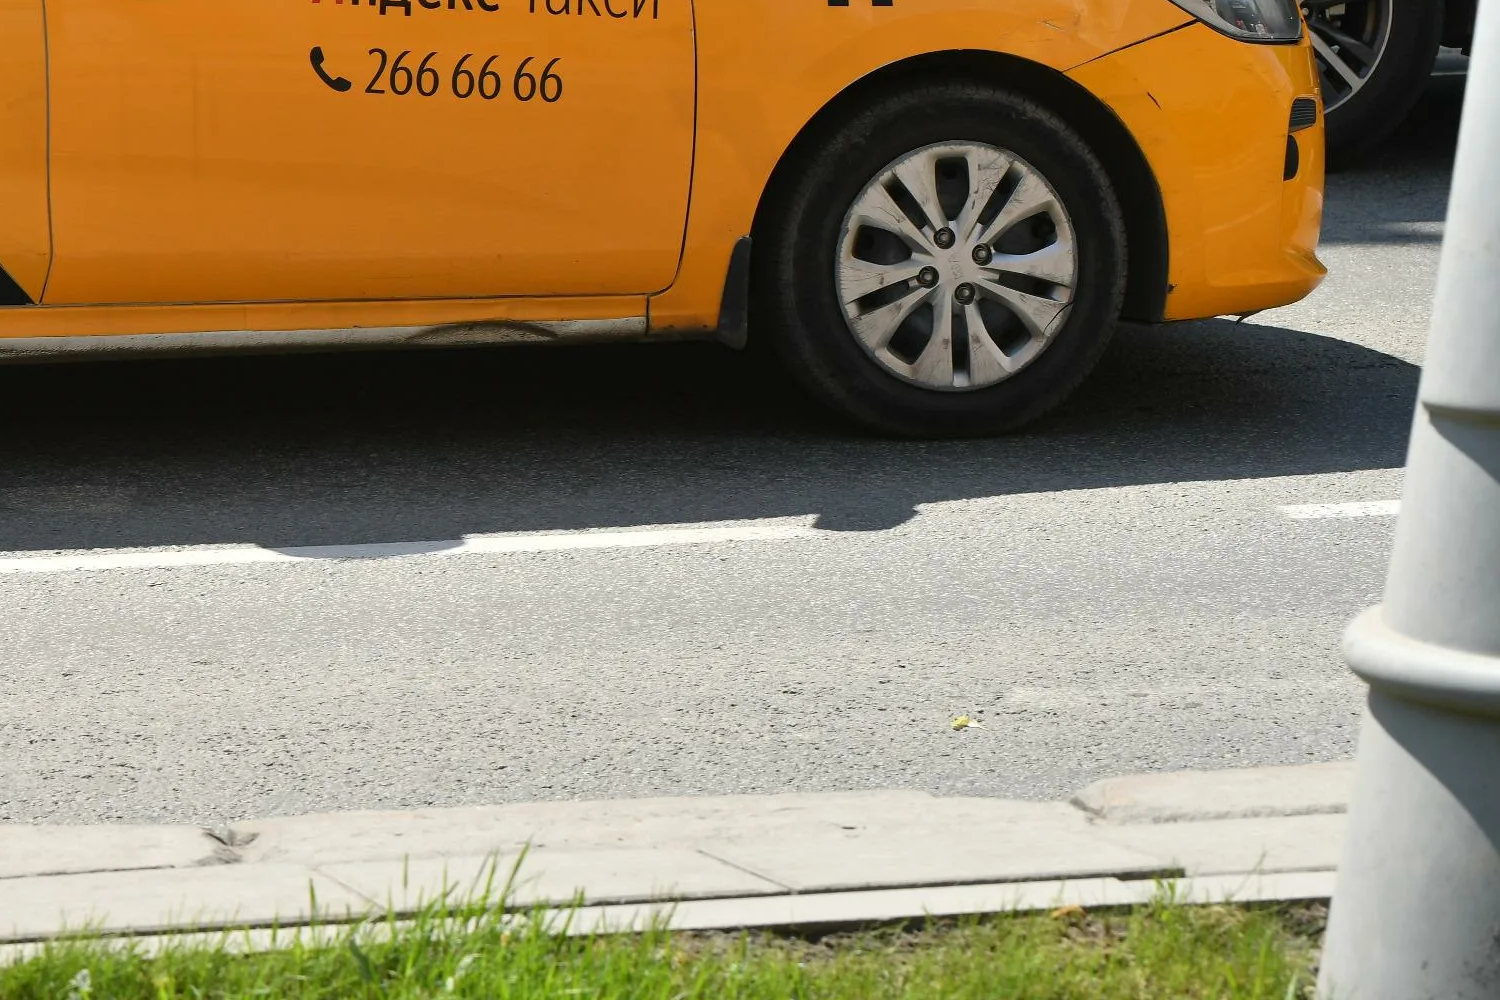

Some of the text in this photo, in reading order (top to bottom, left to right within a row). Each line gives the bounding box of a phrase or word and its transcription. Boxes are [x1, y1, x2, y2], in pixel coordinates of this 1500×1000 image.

[364, 47, 564, 103] 266 66 66
